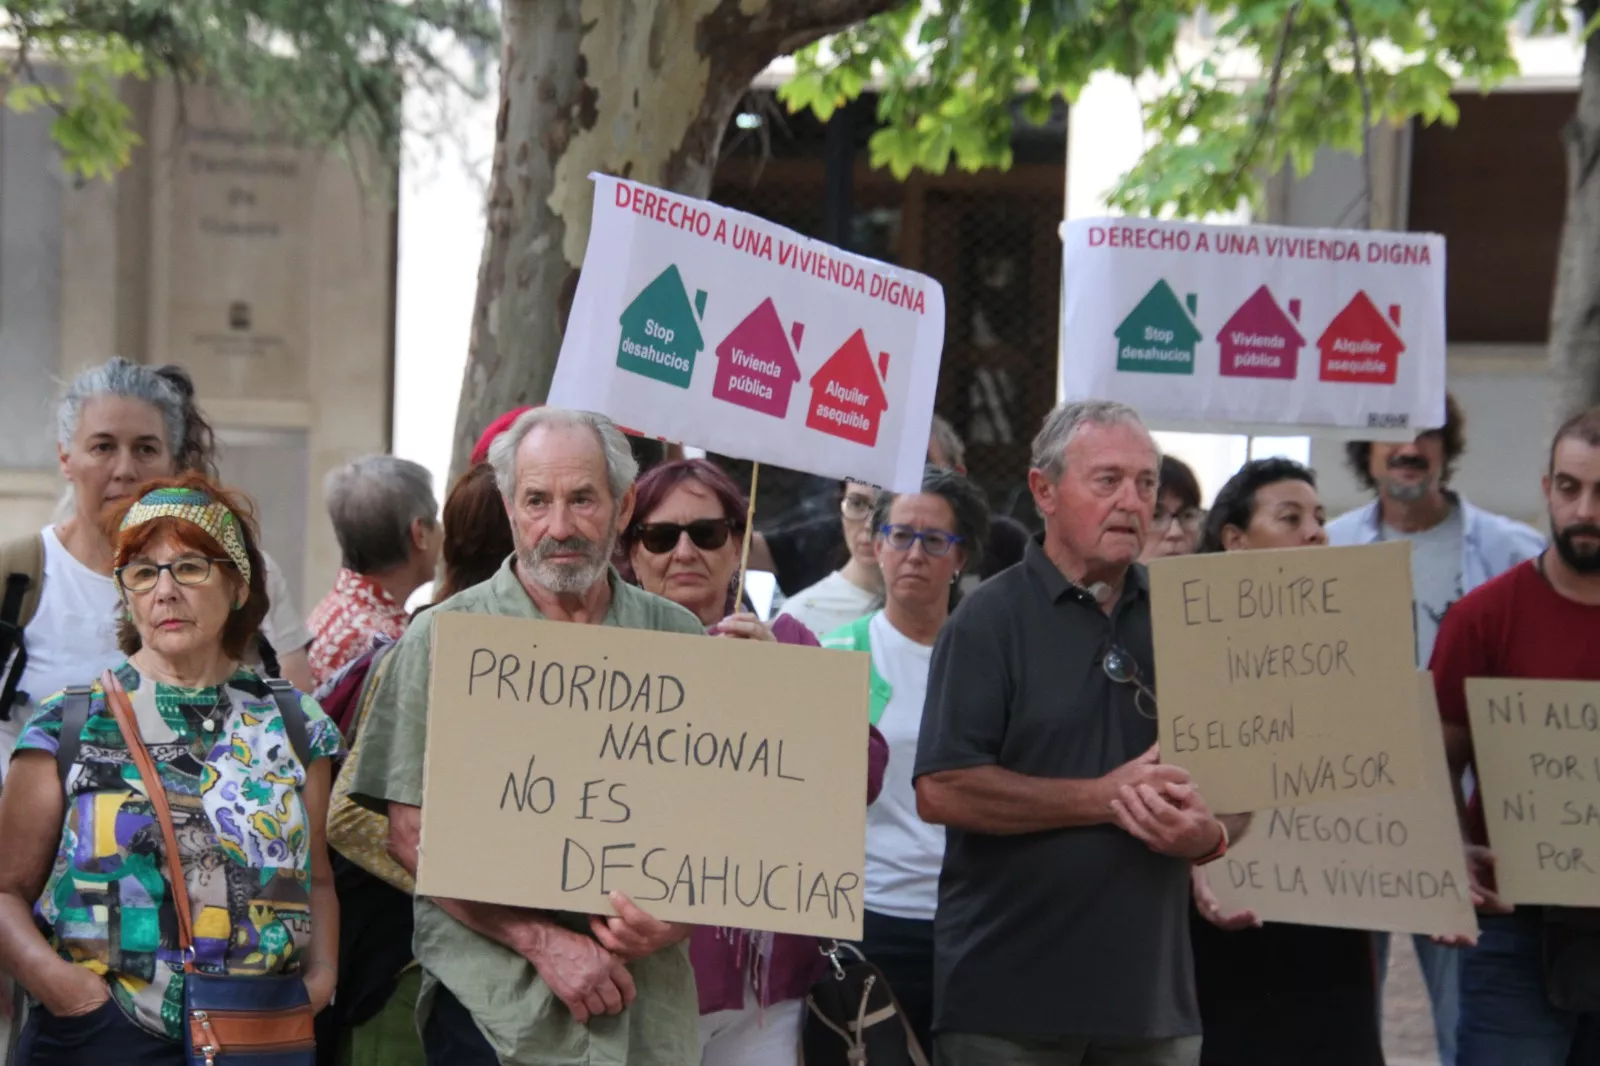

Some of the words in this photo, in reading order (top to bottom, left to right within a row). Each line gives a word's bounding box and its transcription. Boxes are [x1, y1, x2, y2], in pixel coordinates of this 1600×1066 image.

[615, 182, 711, 236] DERECHO
[713, 218, 726, 245] A
[733, 224, 772, 261] UNA
[779, 240, 865, 294] VIVIENDA
[869, 273, 925, 314] DIGNA
[1088, 226, 1191, 252] DERECHO
[1195, 232, 1209, 252] A
[1216, 233, 1259, 256] UNA
[1265, 237, 1361, 263] VIVIENDA
[1367, 242, 1431, 266] DIGNA
[644, 318, 675, 344] Stop
[1144, 325, 1174, 344] Stop
[1229, 331, 1285, 348] Vivienda
[1332, 337, 1383, 356] Alquiler
[622, 337, 690, 372] desahucios
[731, 347, 782, 378] Vivienda
[1121, 345, 1191, 362] desahucios
[1234, 353, 1280, 369] pública
[1327, 358, 1387, 376] asequible
[728, 374, 773, 401] pública
[825, 380, 870, 406] Alquiler
[816, 404, 871, 431] asequible
[1182, 578, 1224, 626] EL
[1237, 567, 1341, 620] BUITRE
[1227, 636, 1356, 684] INVERSOR
[469, 644, 685, 714] PRIORIDAD
[1172, 715, 1199, 753] ES
[1207, 720, 1232, 750] EL
[1238, 701, 1295, 748] GRAN
[599, 722, 805, 782] NACIONAL
[1530, 753, 1585, 781] POR
[500, 755, 555, 814] NO
[575, 779, 632, 823] ES
[1272, 751, 1396, 799] INVASOR
[1268, 807, 1408, 847] NEGOCIO
[1536, 842, 1596, 874] POR
[561, 838, 860, 922] DESAHUCIAR
[1227, 859, 1265, 889] DE
[1274, 863, 1308, 896] LA
[1322, 859, 1461, 901] VIVIENDA
